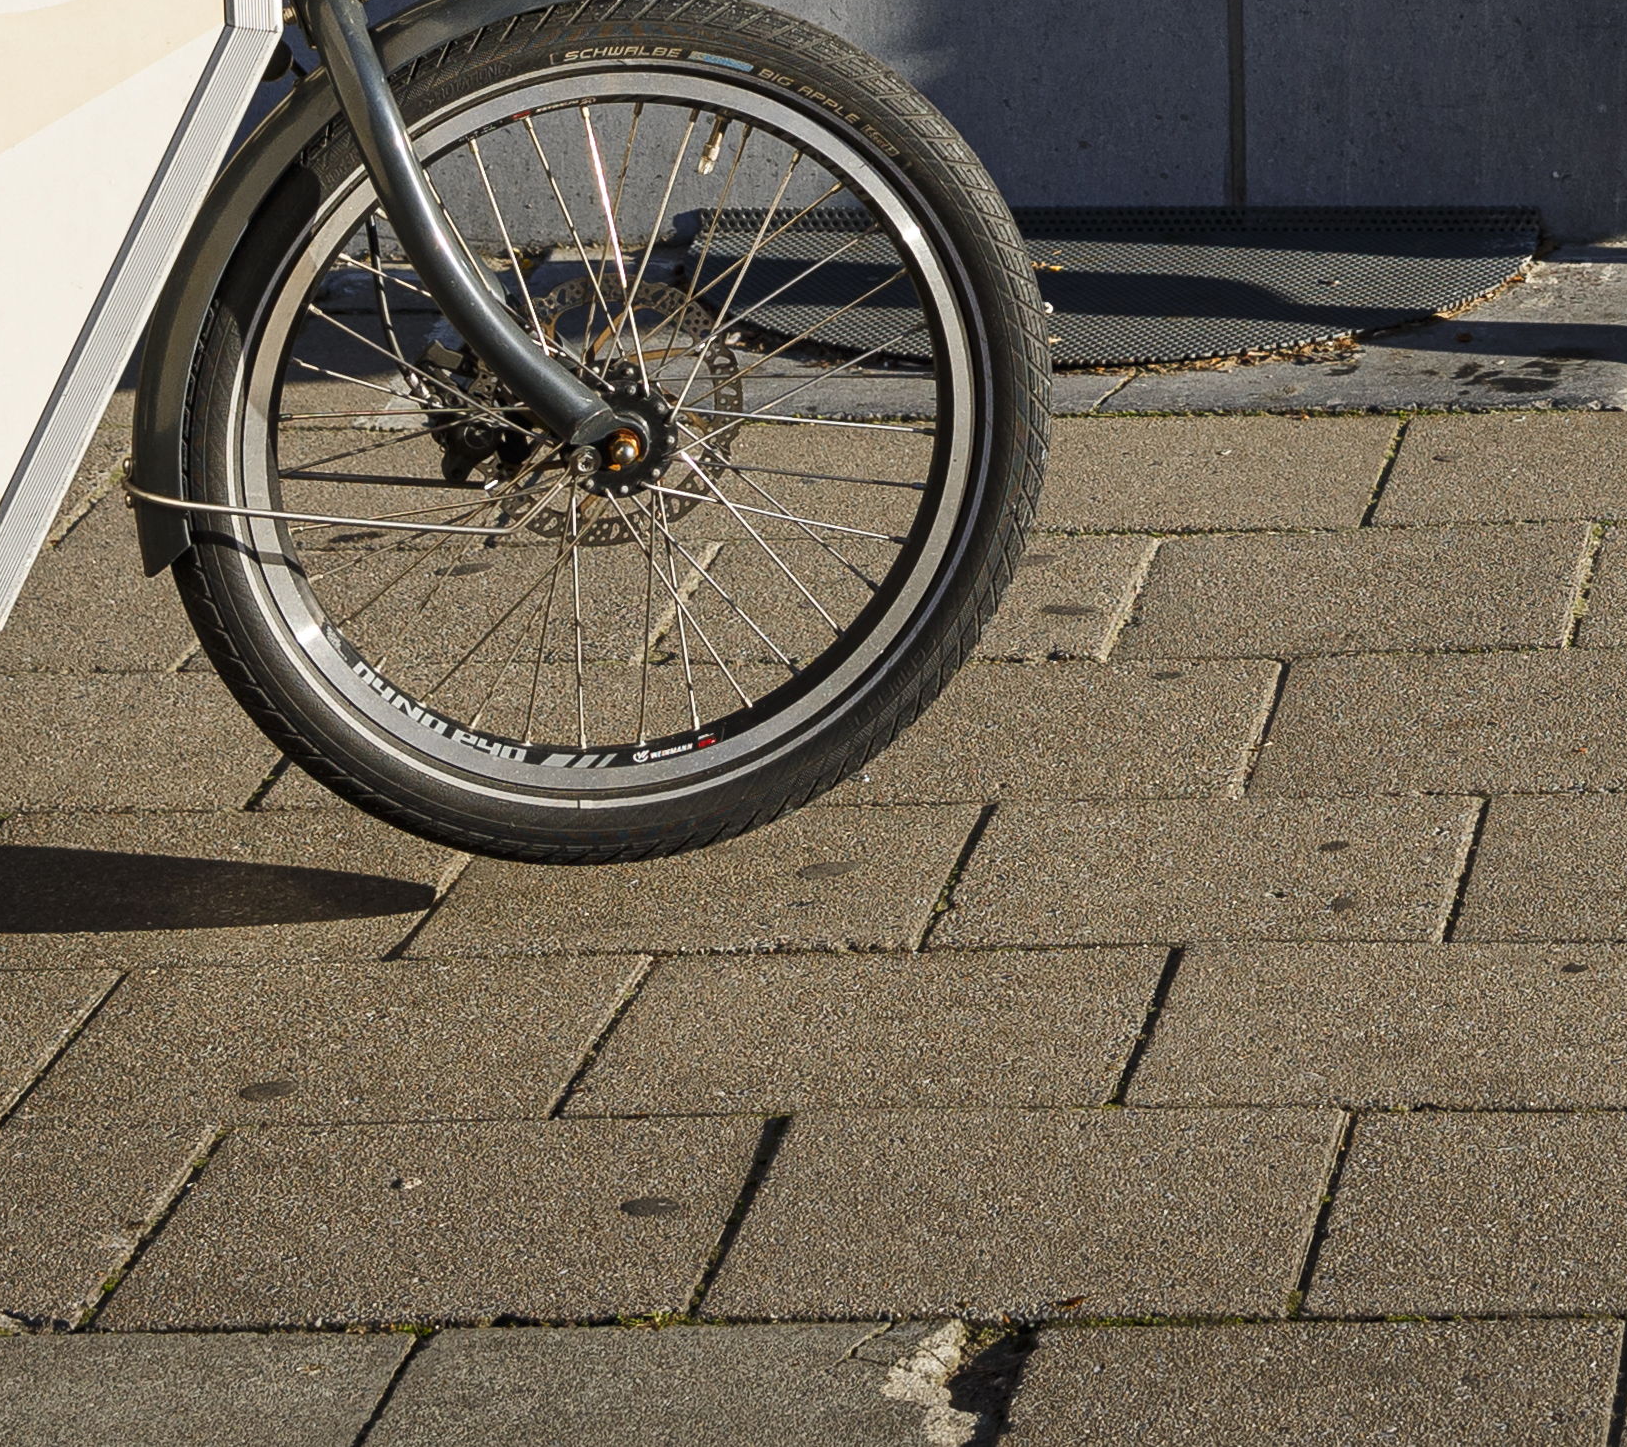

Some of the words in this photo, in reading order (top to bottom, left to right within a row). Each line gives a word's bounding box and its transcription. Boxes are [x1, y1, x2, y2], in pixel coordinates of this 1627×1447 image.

[563, 45, 683, 62] SCHWALBE
[758, 68, 795, 87] BIG
[797, 85, 861, 124] APPLE
